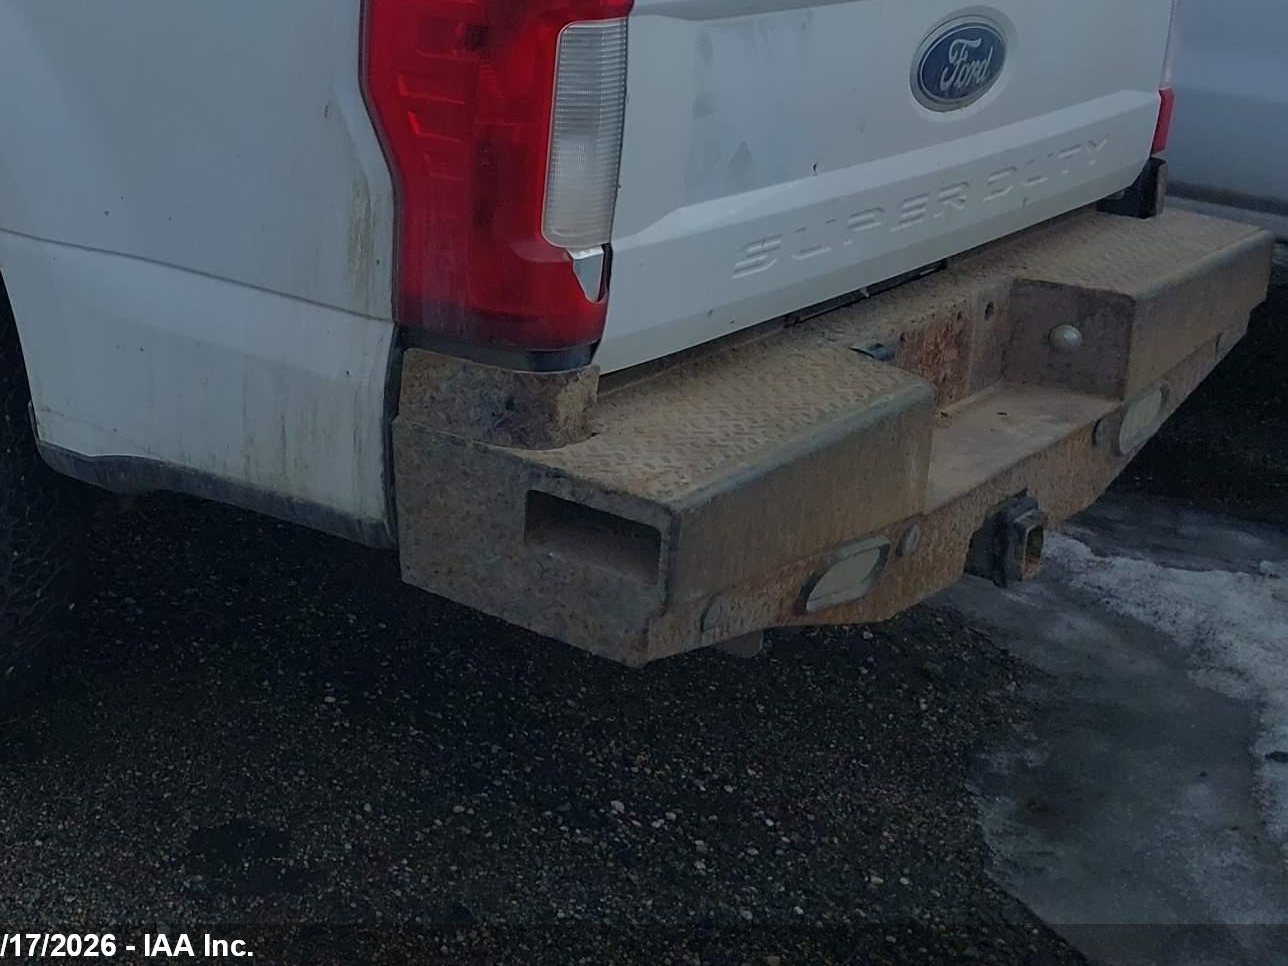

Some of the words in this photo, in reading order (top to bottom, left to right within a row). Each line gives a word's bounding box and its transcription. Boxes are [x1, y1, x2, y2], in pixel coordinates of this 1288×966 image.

[940, 38, 993, 91] Ford
[731, 179, 970, 280] SUPER
[982, 136, 1108, 203] DUTY
